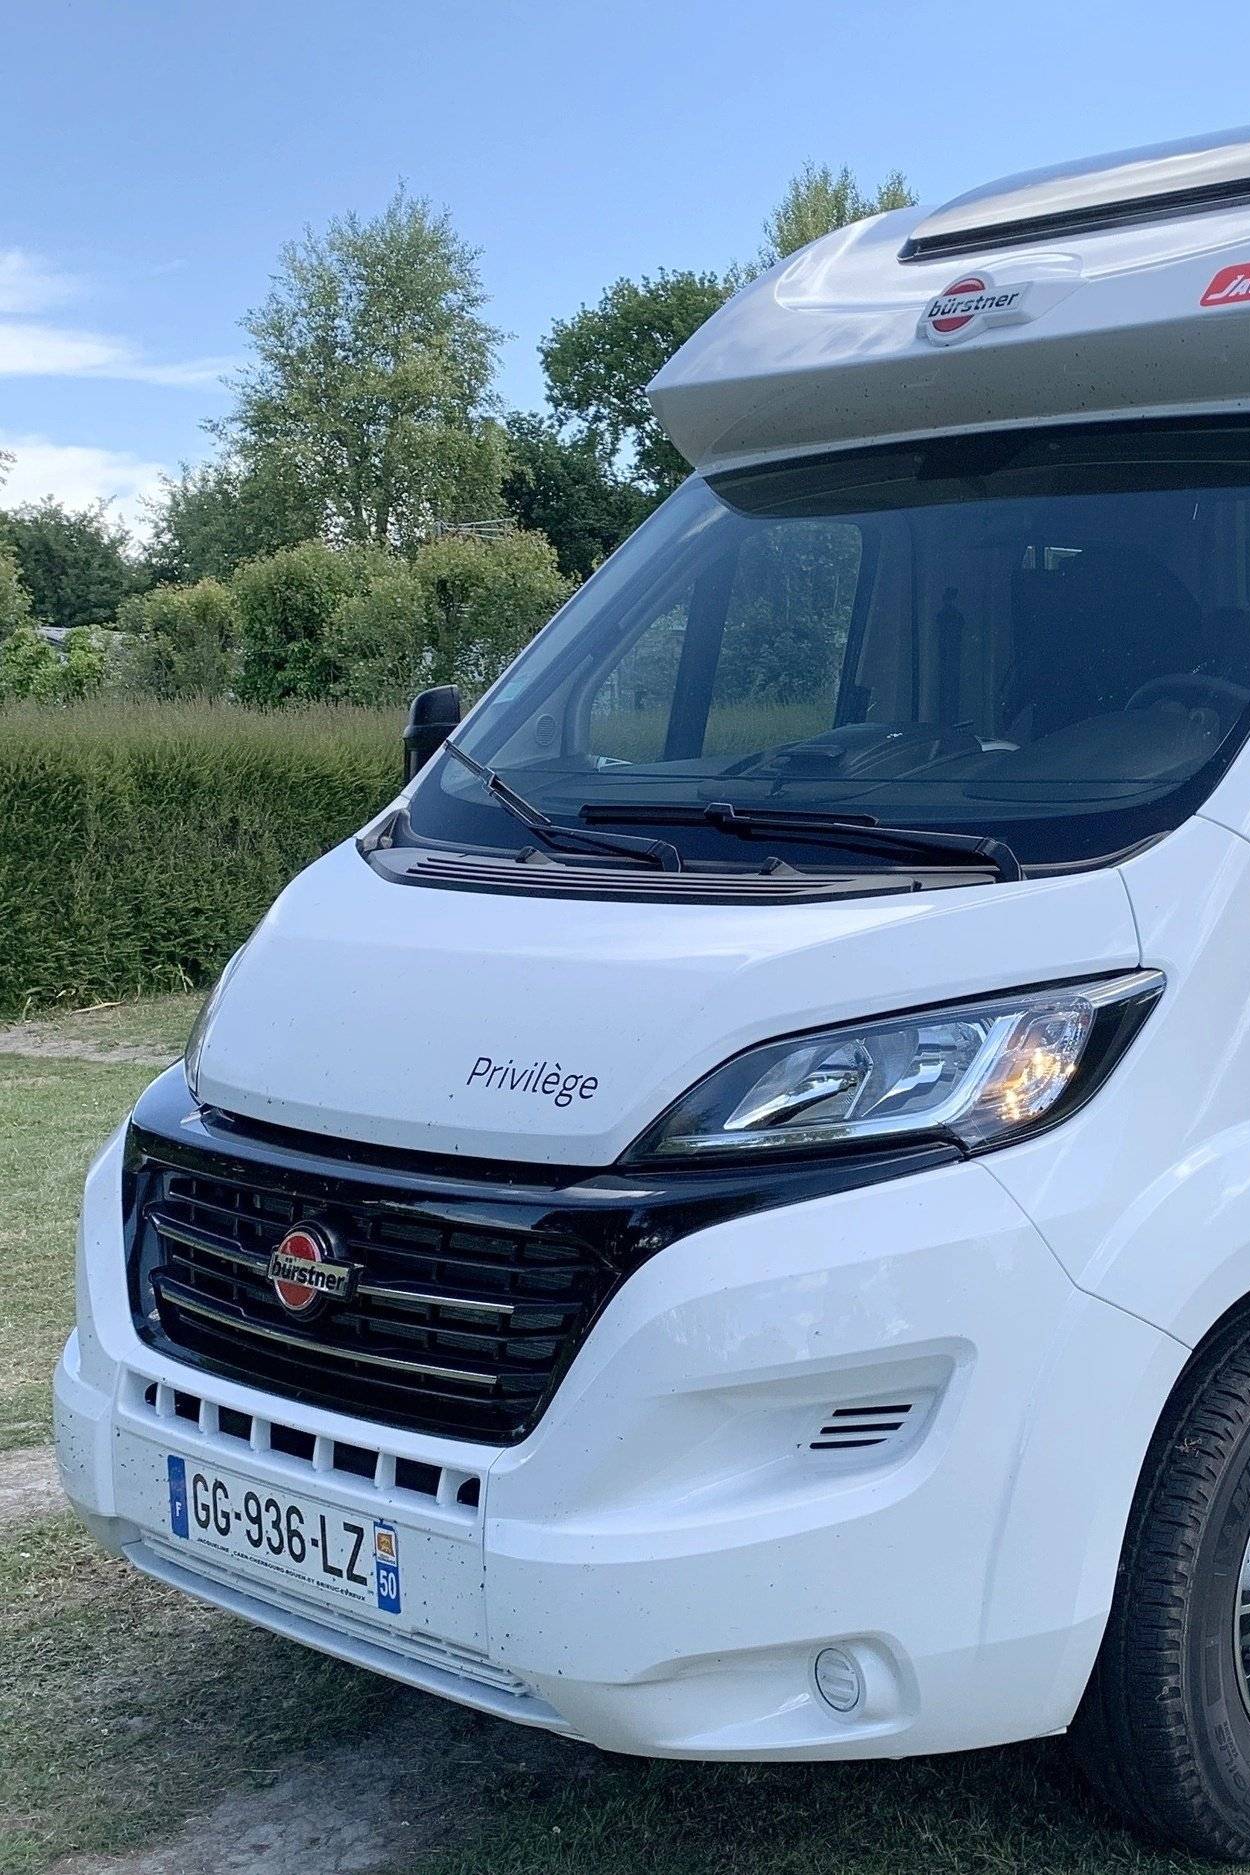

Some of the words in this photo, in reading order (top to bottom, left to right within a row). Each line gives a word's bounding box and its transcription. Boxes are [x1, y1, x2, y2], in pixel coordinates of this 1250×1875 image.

[929, 291, 1019, 318] bürstner
[466, 1057, 598, 1107] Privilège
[273, 1257, 345, 1291] bürstner
[175, 1501, 183, 1517] F
[192, 1473, 368, 1586] GG-936-LZ
[379, 1568, 397, 1600] 50
